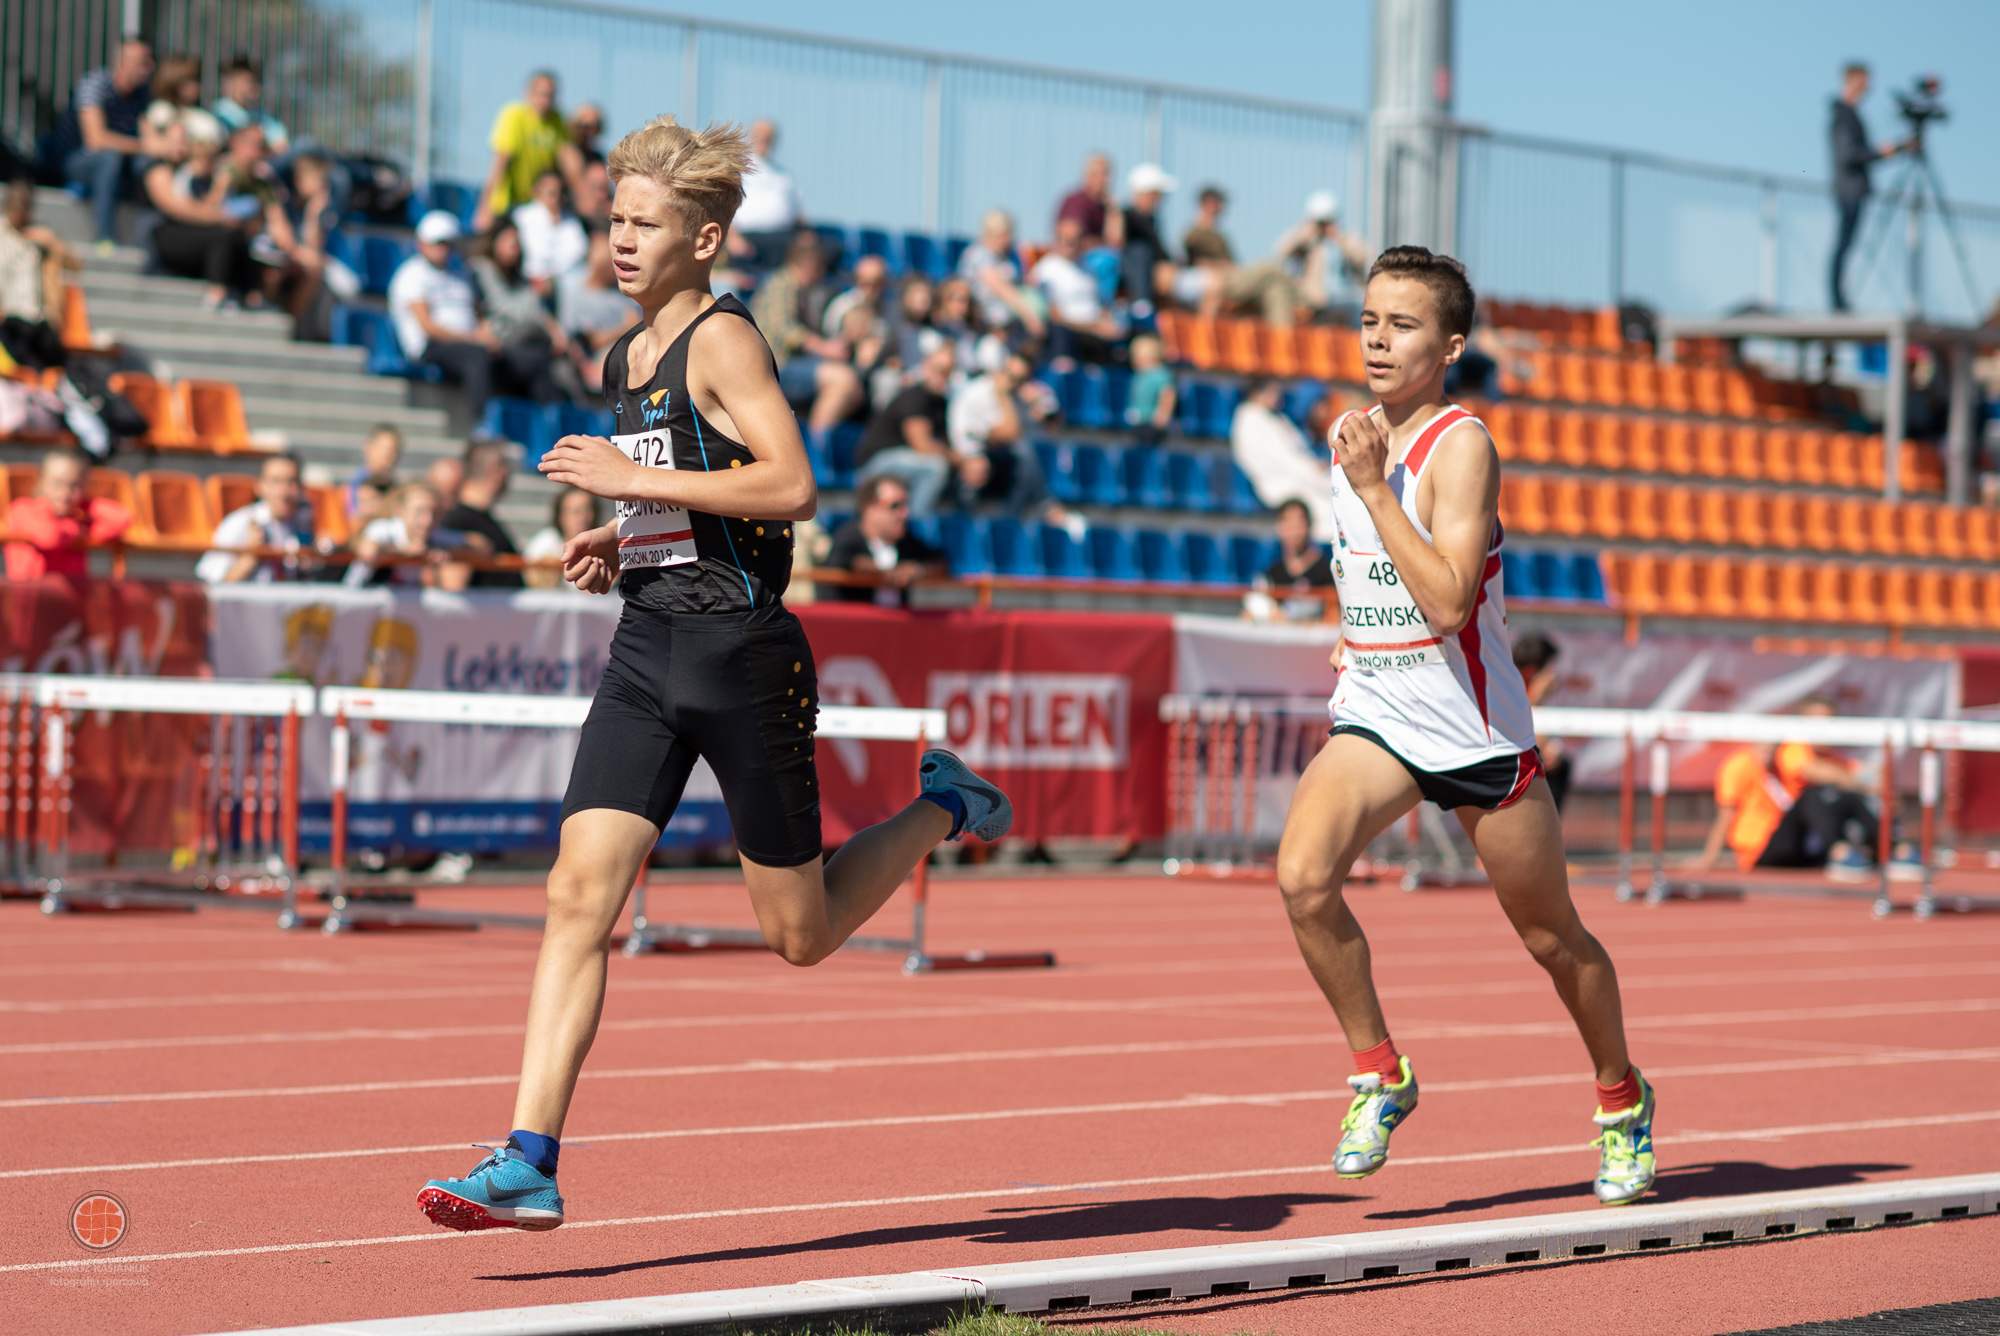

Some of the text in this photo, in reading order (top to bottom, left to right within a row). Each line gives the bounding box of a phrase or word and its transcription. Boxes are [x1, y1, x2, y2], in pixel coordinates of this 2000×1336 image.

[633, 437, 668, 466] 472
[649, 548, 672, 563] 2019
[1395, 652, 1425, 667] 2019
[945, 692, 1115, 750] ORLEN
